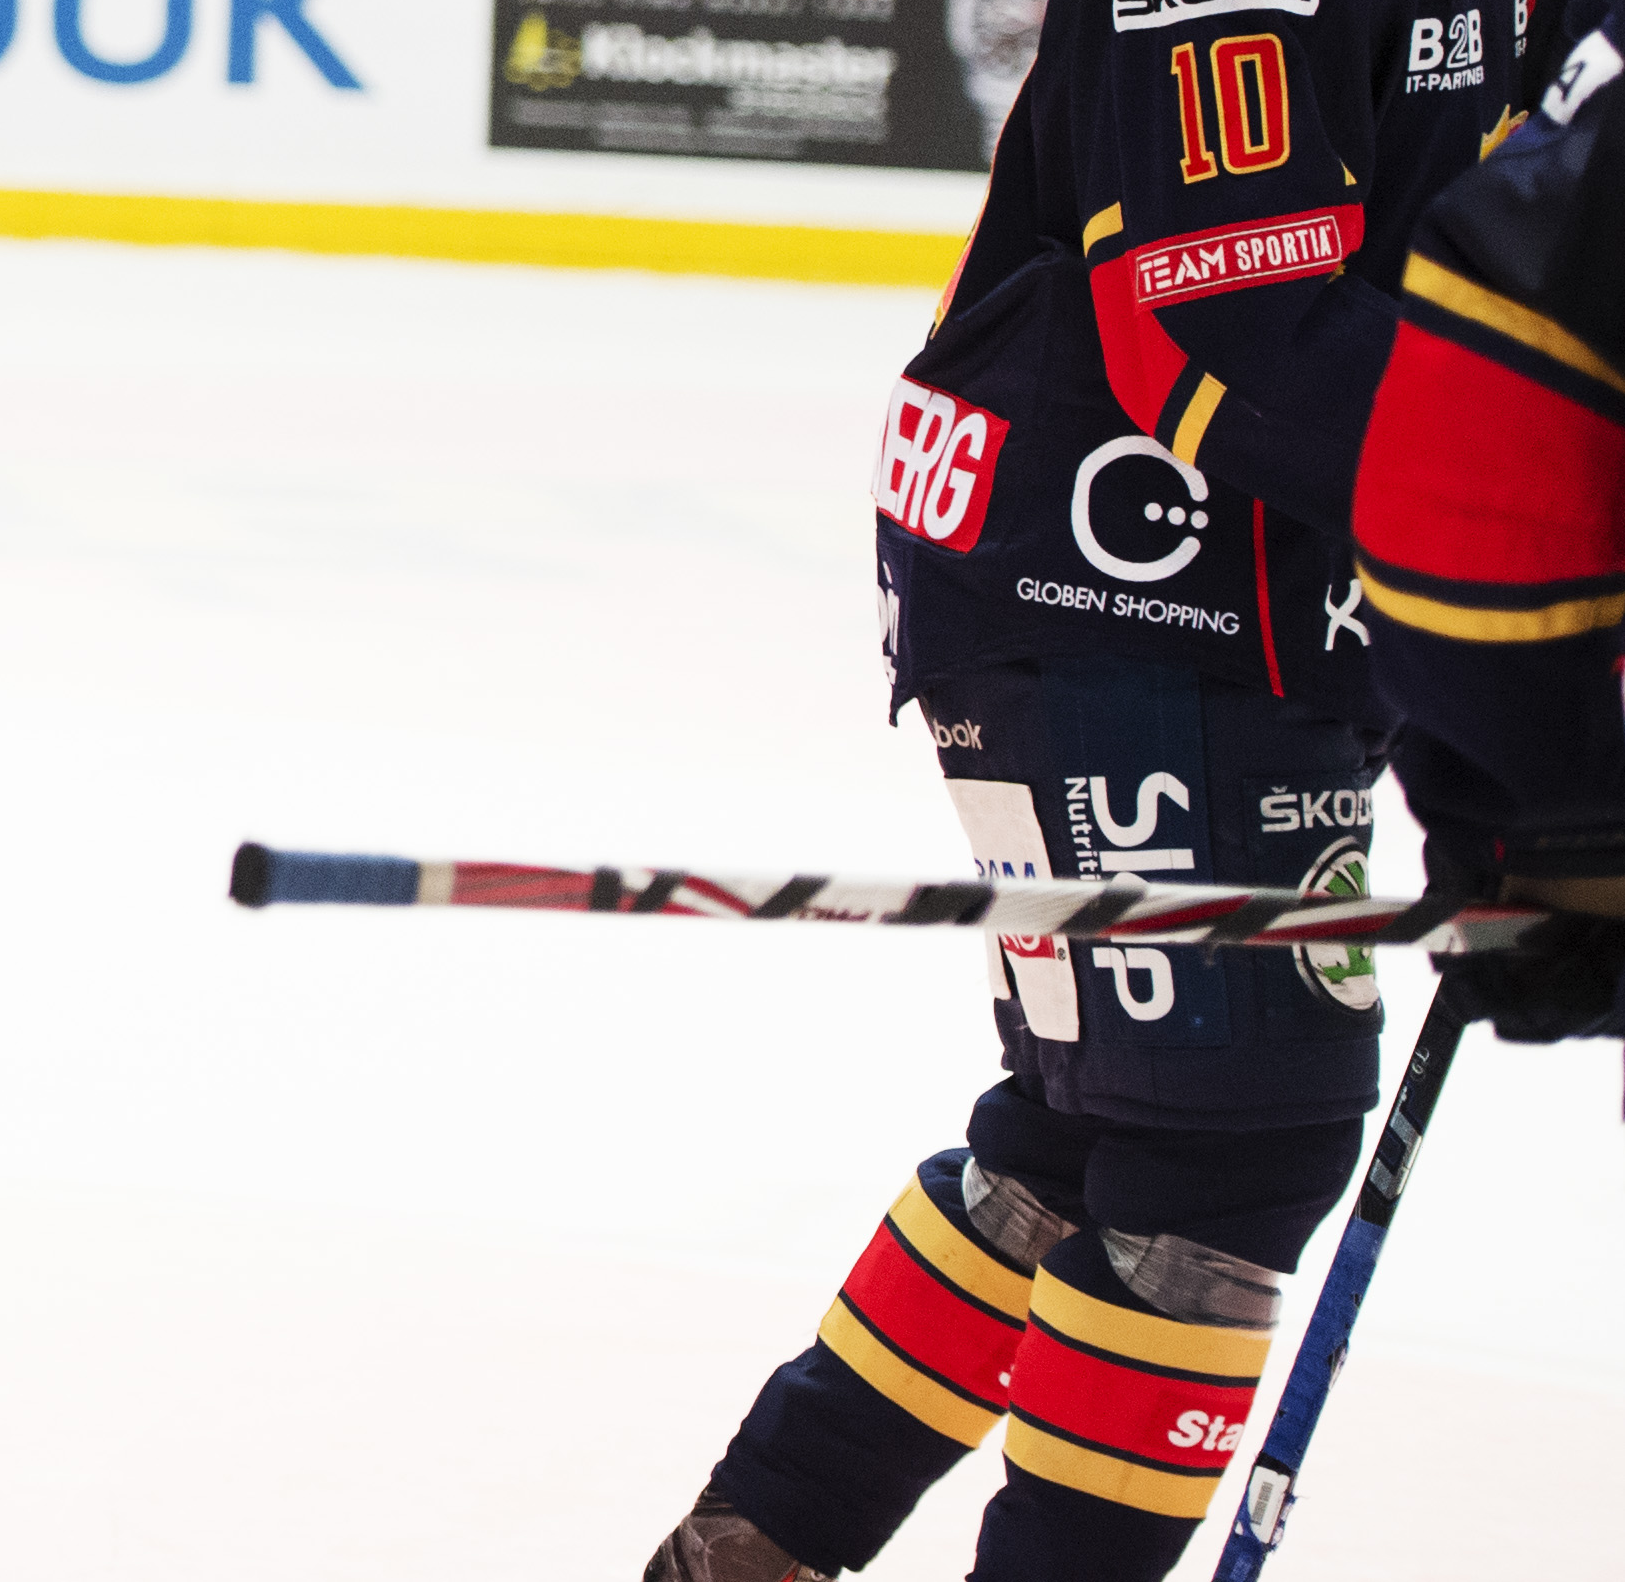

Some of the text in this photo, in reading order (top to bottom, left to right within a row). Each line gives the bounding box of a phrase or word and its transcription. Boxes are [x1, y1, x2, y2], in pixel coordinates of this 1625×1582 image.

[1408, 9, 1482, 73] B2B
[1171, 32, 1291, 185] 10
[1139, 224, 1333, 294] TEAM SPORTIA
[871, 378, 987, 540] ERG
[1016, 577, 1240, 635] GLOBEN SHOPPING
[1064, 777, 1102, 882] Nutriti
